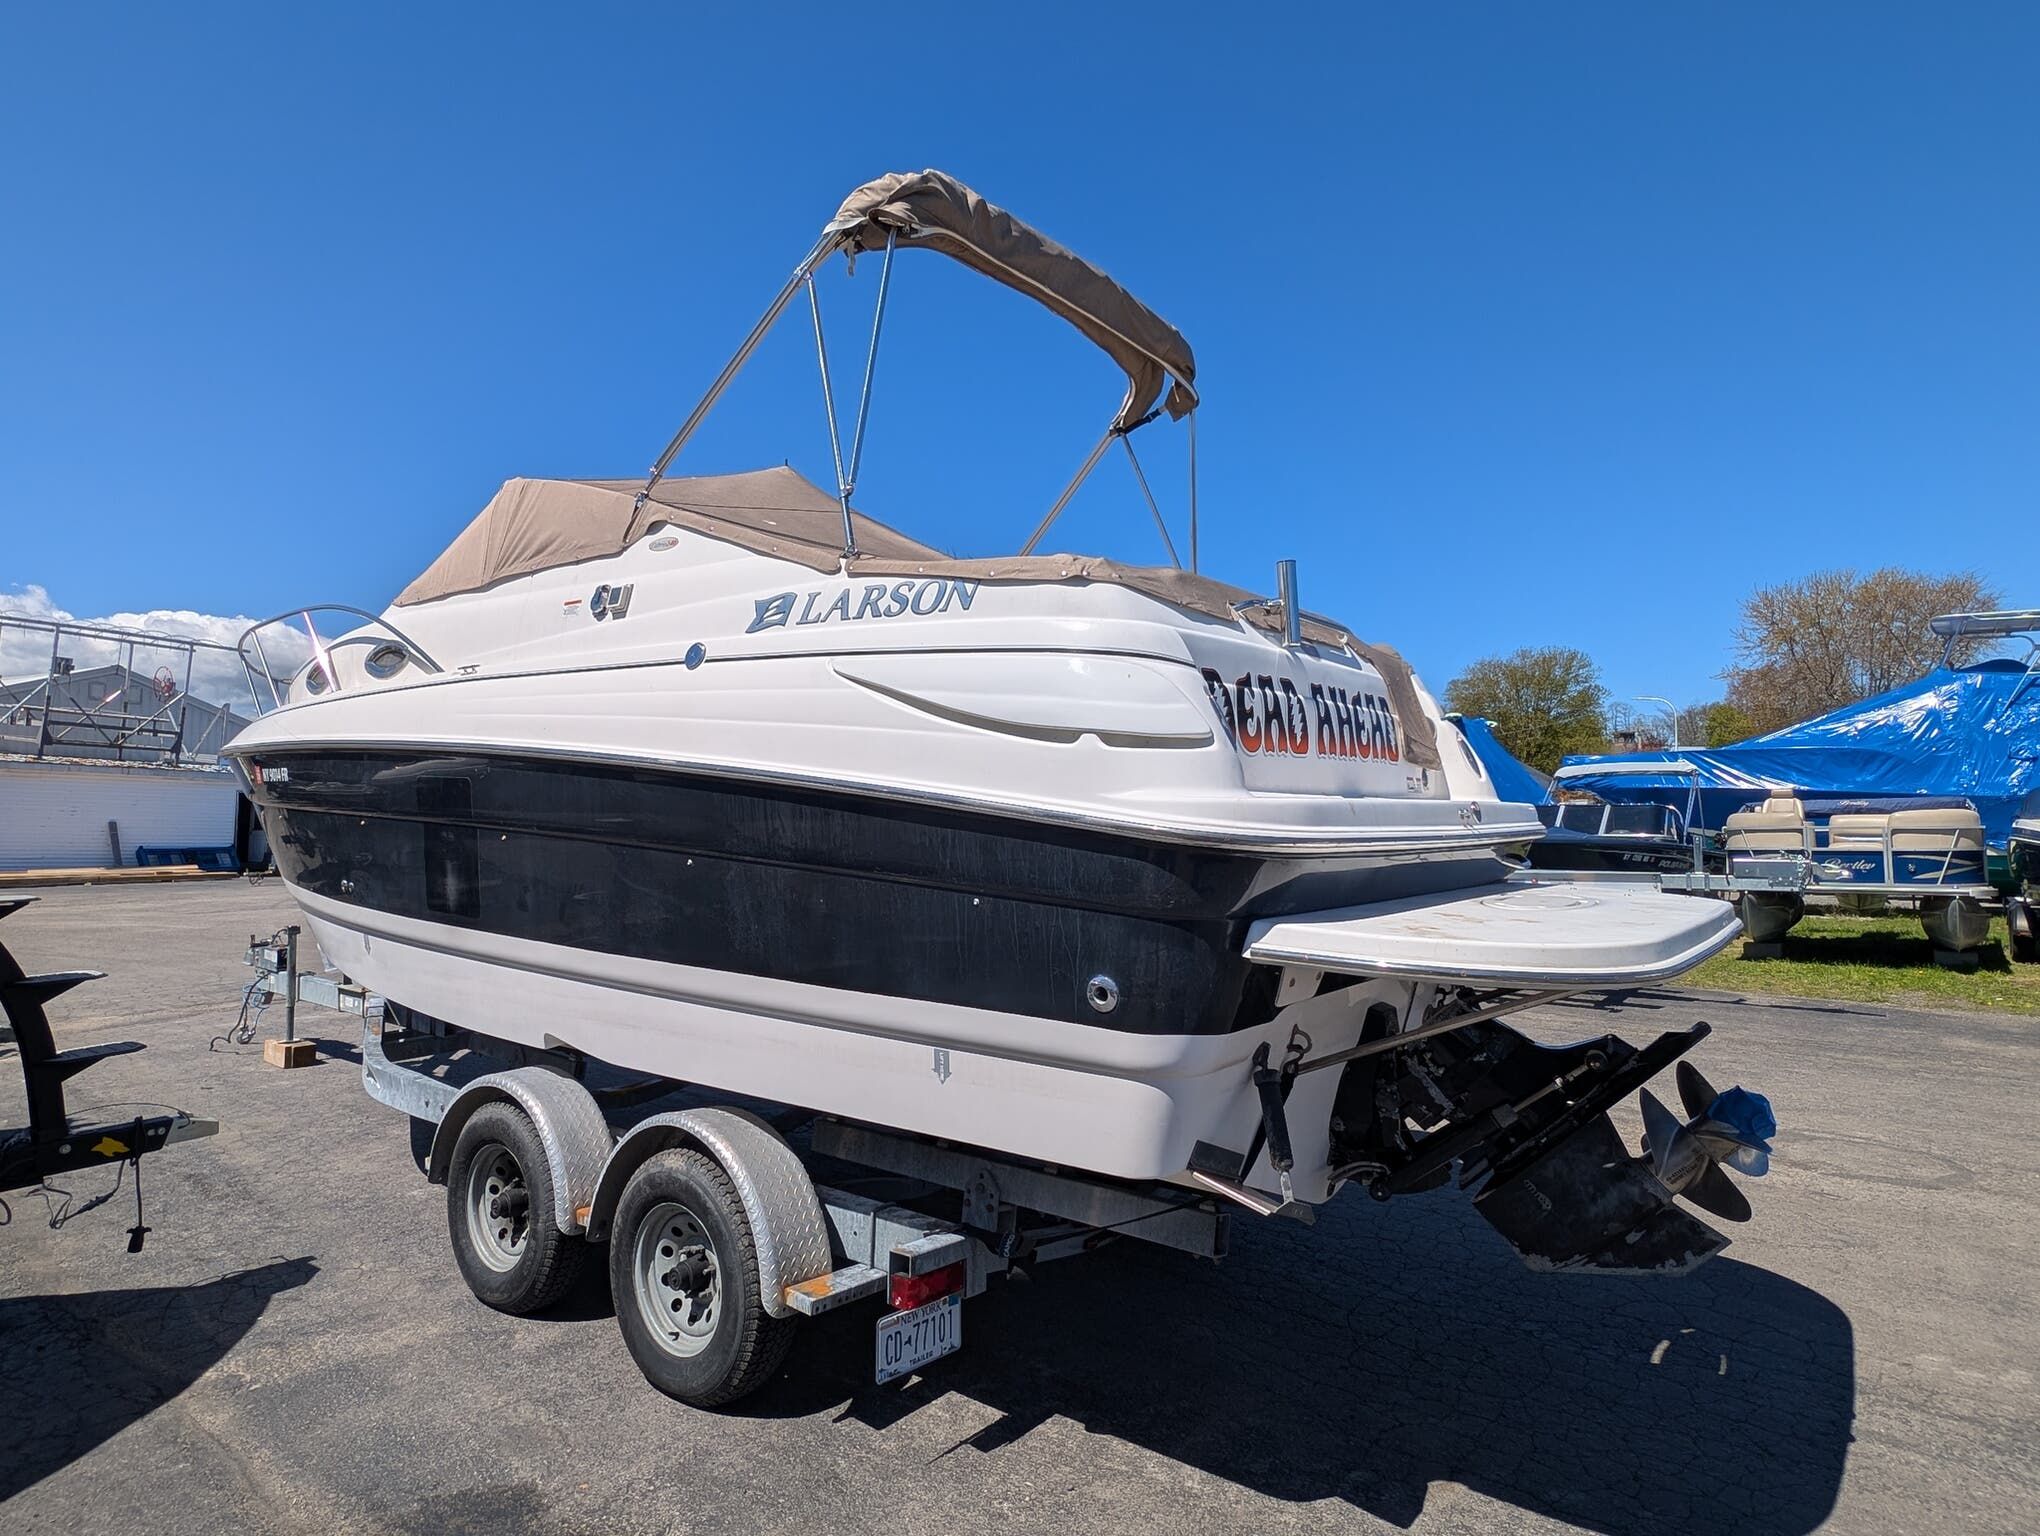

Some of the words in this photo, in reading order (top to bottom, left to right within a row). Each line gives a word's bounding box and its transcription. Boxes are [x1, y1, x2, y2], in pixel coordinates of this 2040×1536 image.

[796, 579, 981, 626] LARSON
[1201, 667, 1310, 756] DEAD
[1311, 682, 1400, 763] AHEAD
[900, 1309, 919, 1327] NEW
[920, 1301, 942, 1318] YORK
[909, 1350, 934, 1366] TRAILER
